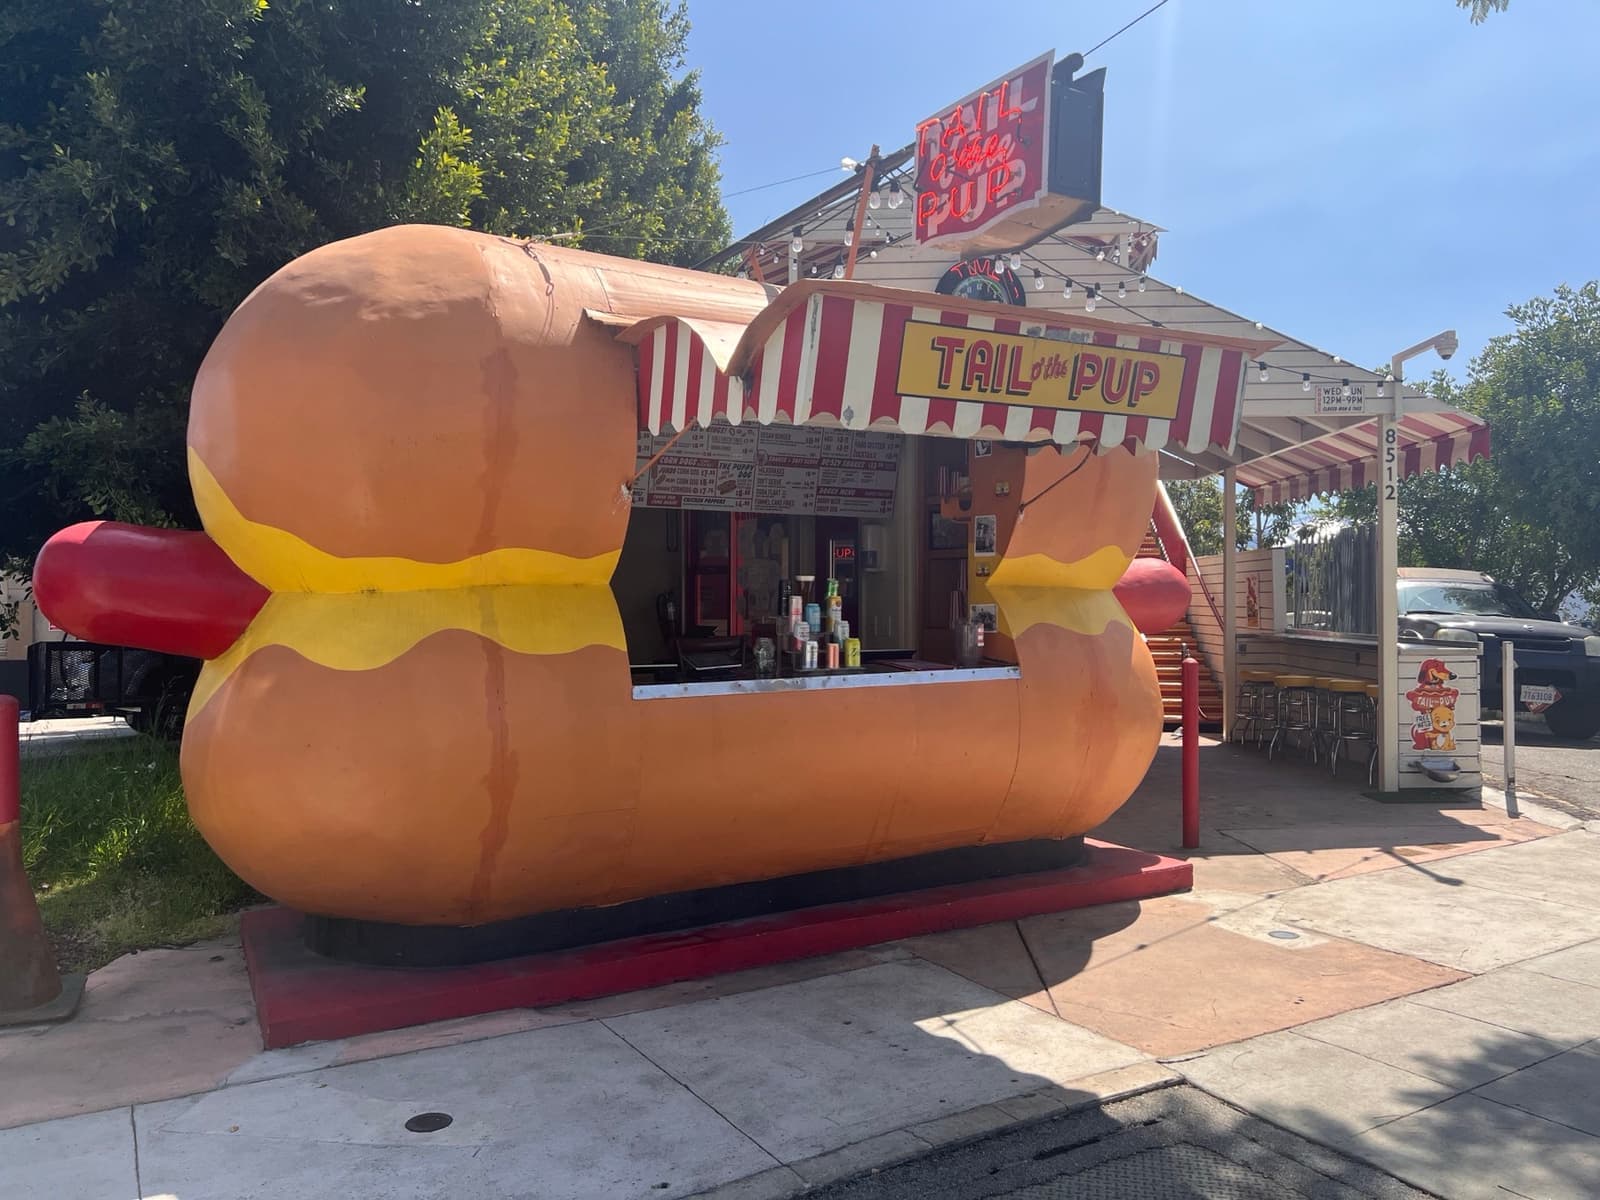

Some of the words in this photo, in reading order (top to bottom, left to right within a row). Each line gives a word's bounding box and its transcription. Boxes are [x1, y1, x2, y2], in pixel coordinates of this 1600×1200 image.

[915, 76, 1038, 162] TAIL
[918, 159, 1026, 238] PUP
[931, 336, 1033, 396] TAIL
[1068, 352, 1161, 408] PUP
